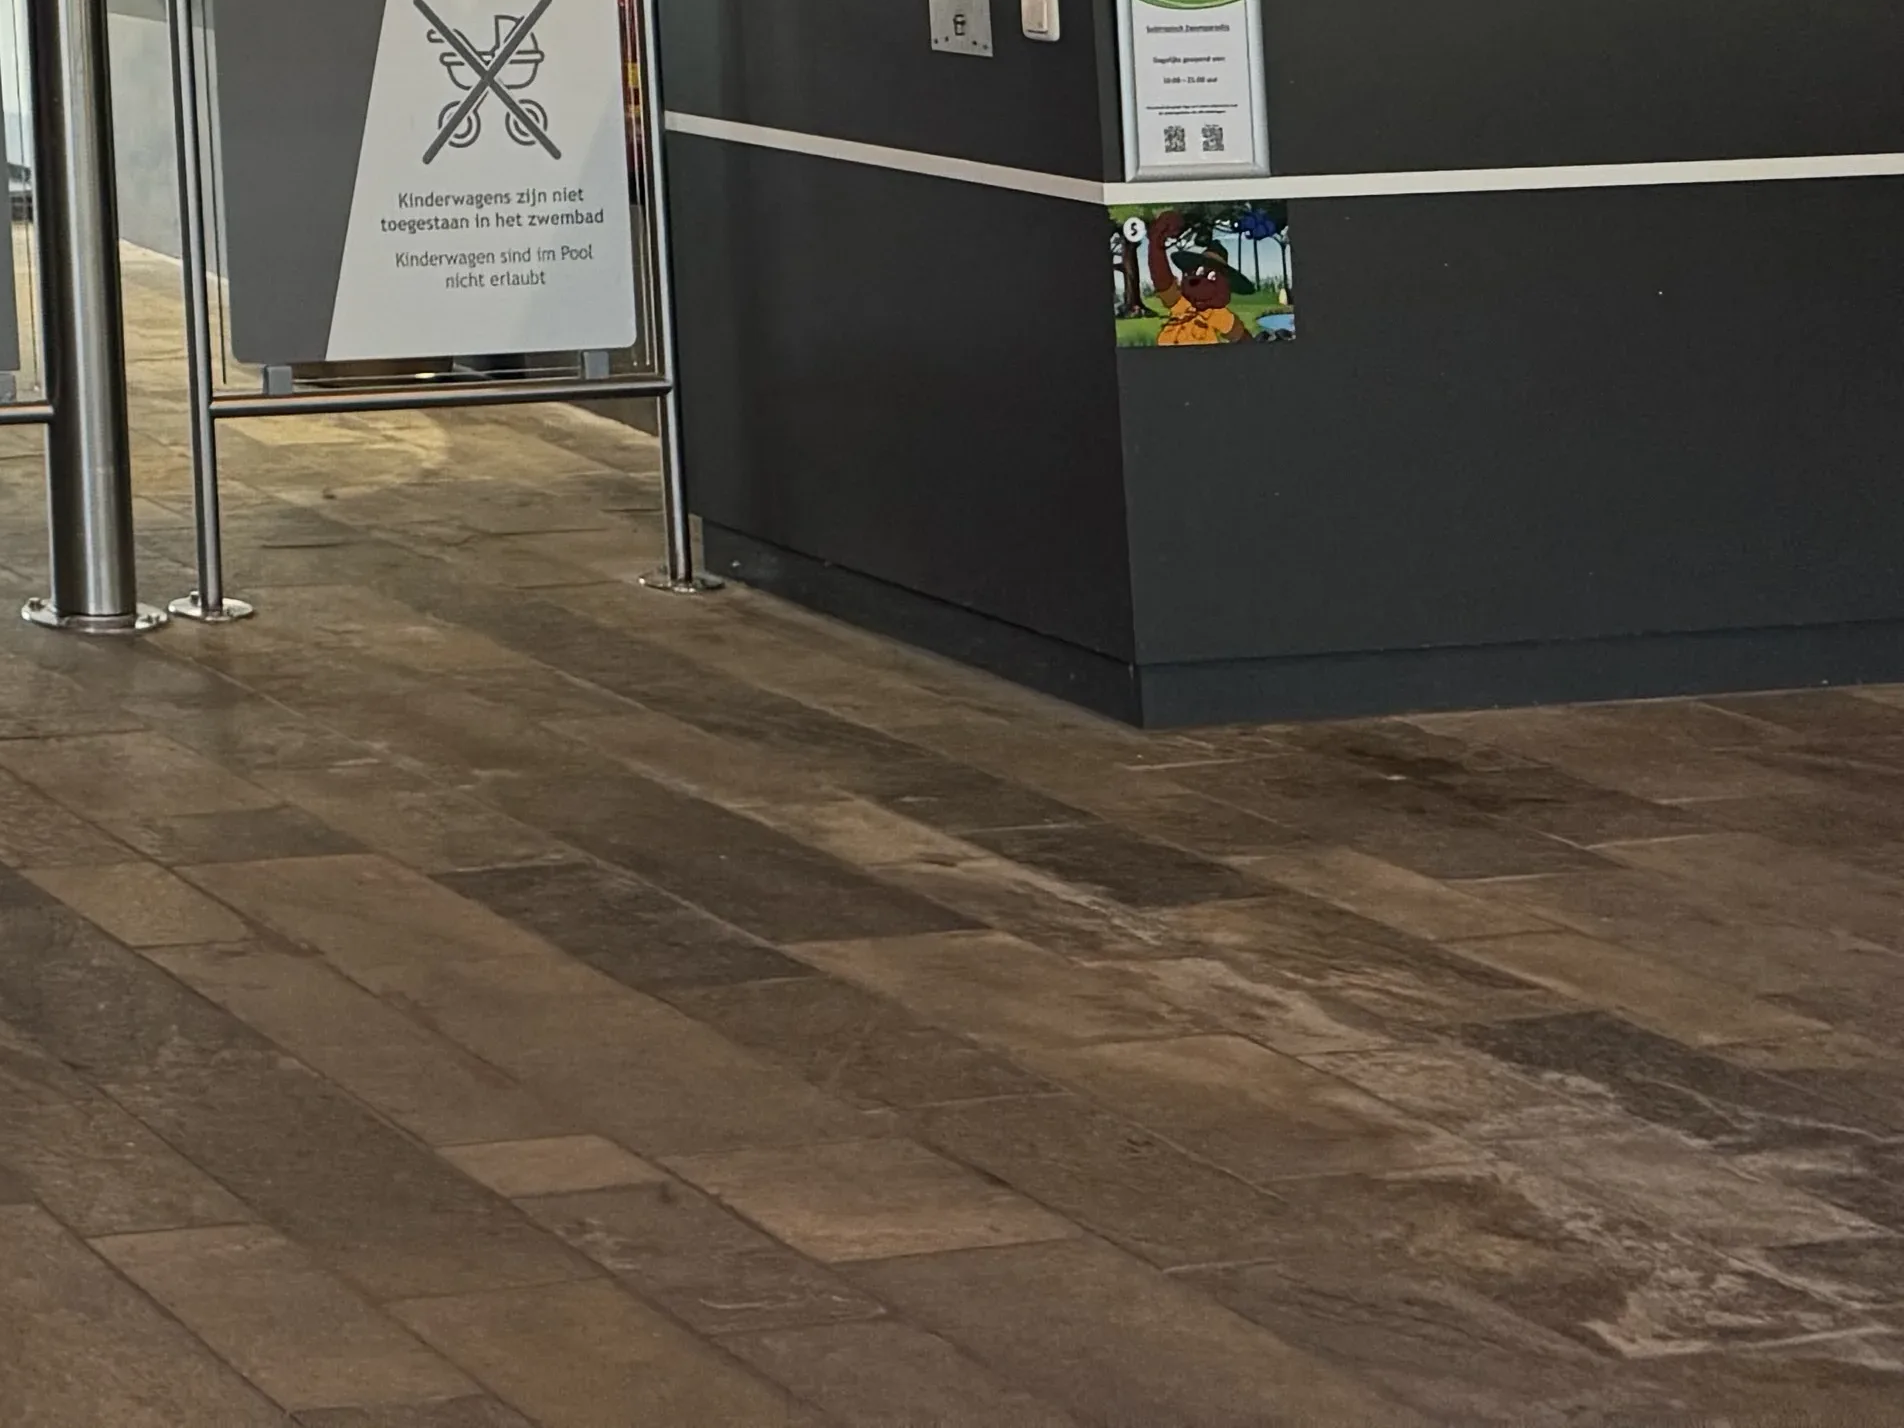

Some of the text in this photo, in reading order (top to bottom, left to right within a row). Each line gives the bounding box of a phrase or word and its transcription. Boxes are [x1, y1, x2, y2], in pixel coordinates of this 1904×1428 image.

[398, 187, 584, 209] Kinderwagens zijn niet
[381, 209, 604, 234] toegestaan in het zwembad
[395, 244, 595, 268] Kinderwagen sind im Pool
[445, 270, 546, 289] nicht erlaubt
